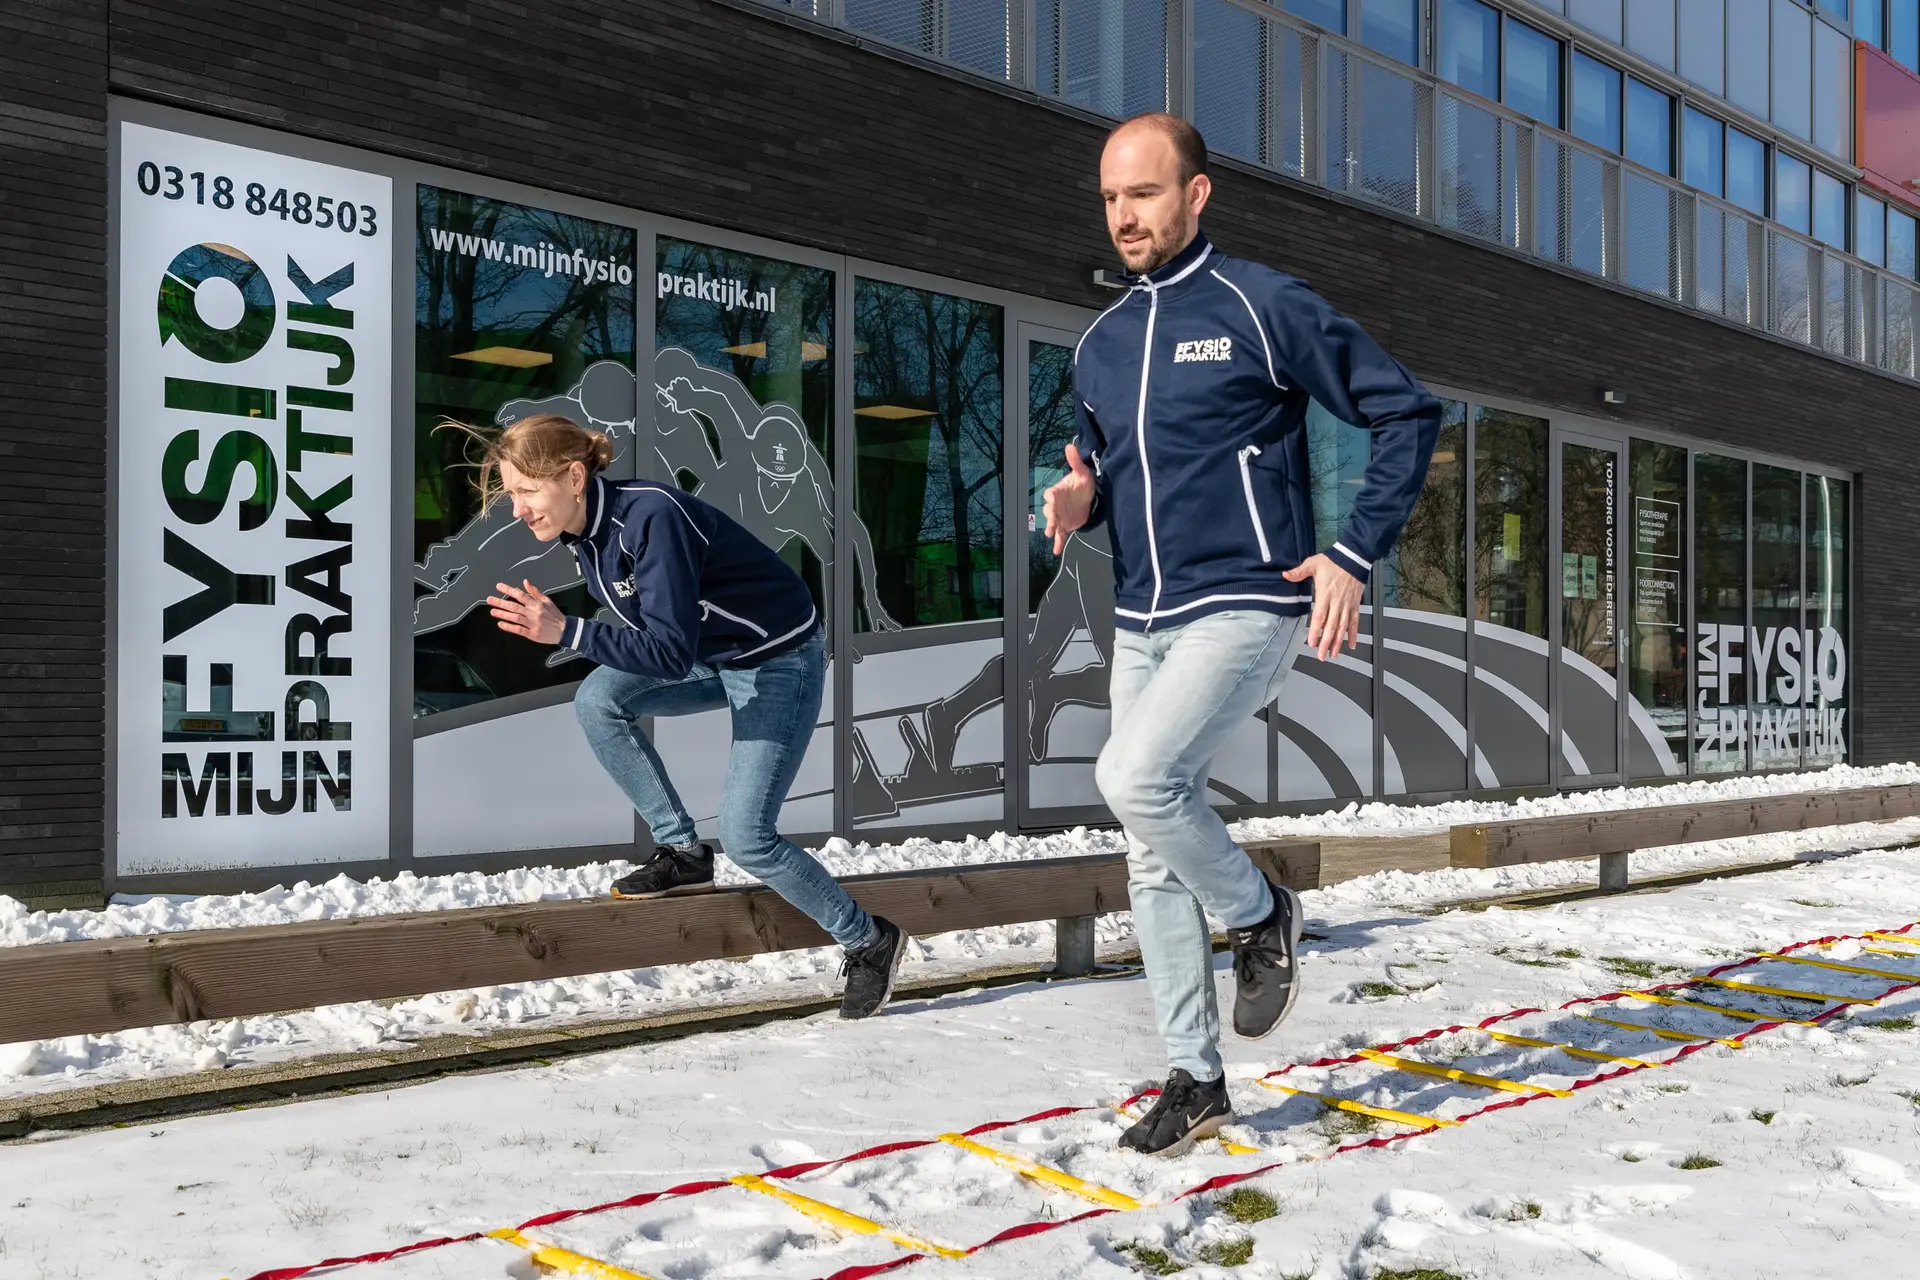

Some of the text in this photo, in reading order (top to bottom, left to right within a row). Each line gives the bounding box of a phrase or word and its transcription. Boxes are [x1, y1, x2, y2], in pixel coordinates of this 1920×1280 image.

[137, 161, 378, 237] 0318 848503
[430, 228, 776, 313] www.mijnfysio praktijk.nl
[1182, 350, 1232, 362] PRAKTIJK
[1183, 337, 1232, 353] FYSIO
[158, 242, 279, 742] FYSIO
[285, 253, 355, 741] PRAKTIJK
[1698, 623, 1718, 761] MIJN
[1719, 624, 1846, 704] FYSIO
[162, 750, 352, 818] MIJN
